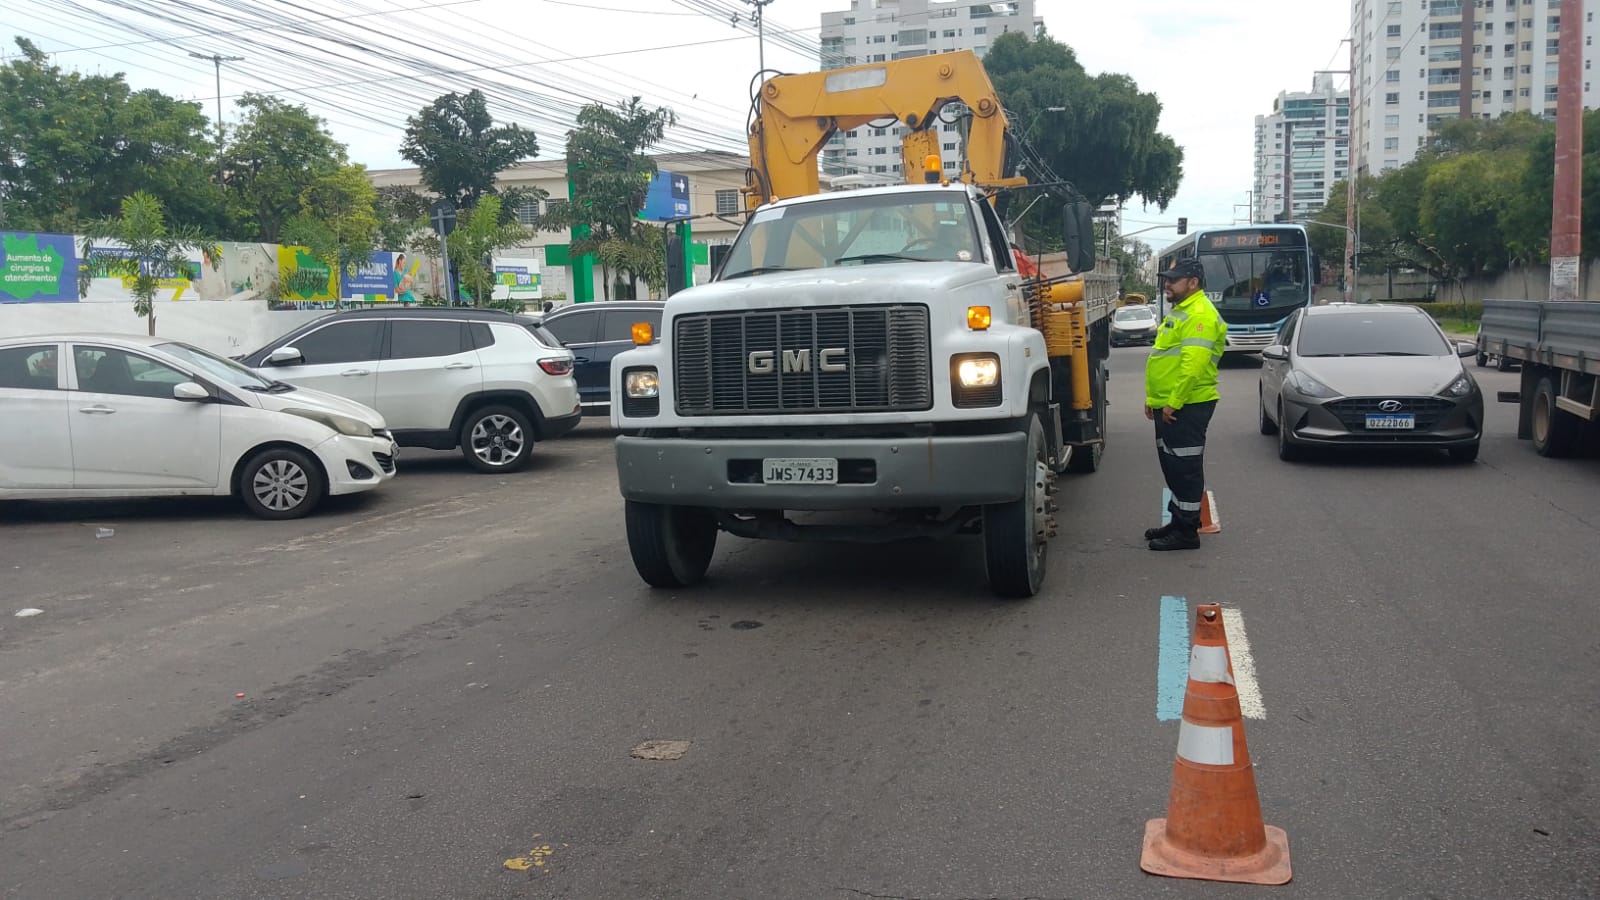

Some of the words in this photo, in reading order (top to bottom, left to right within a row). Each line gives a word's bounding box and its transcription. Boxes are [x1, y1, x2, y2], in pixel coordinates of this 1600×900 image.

[6, 253, 42, 262] Aumento
[43, 254, 52, 262] de
[10, 263, 44, 273] cirurgias
[4, 273, 57, 282] atendimentos
[749, 348, 847, 374] GMC
